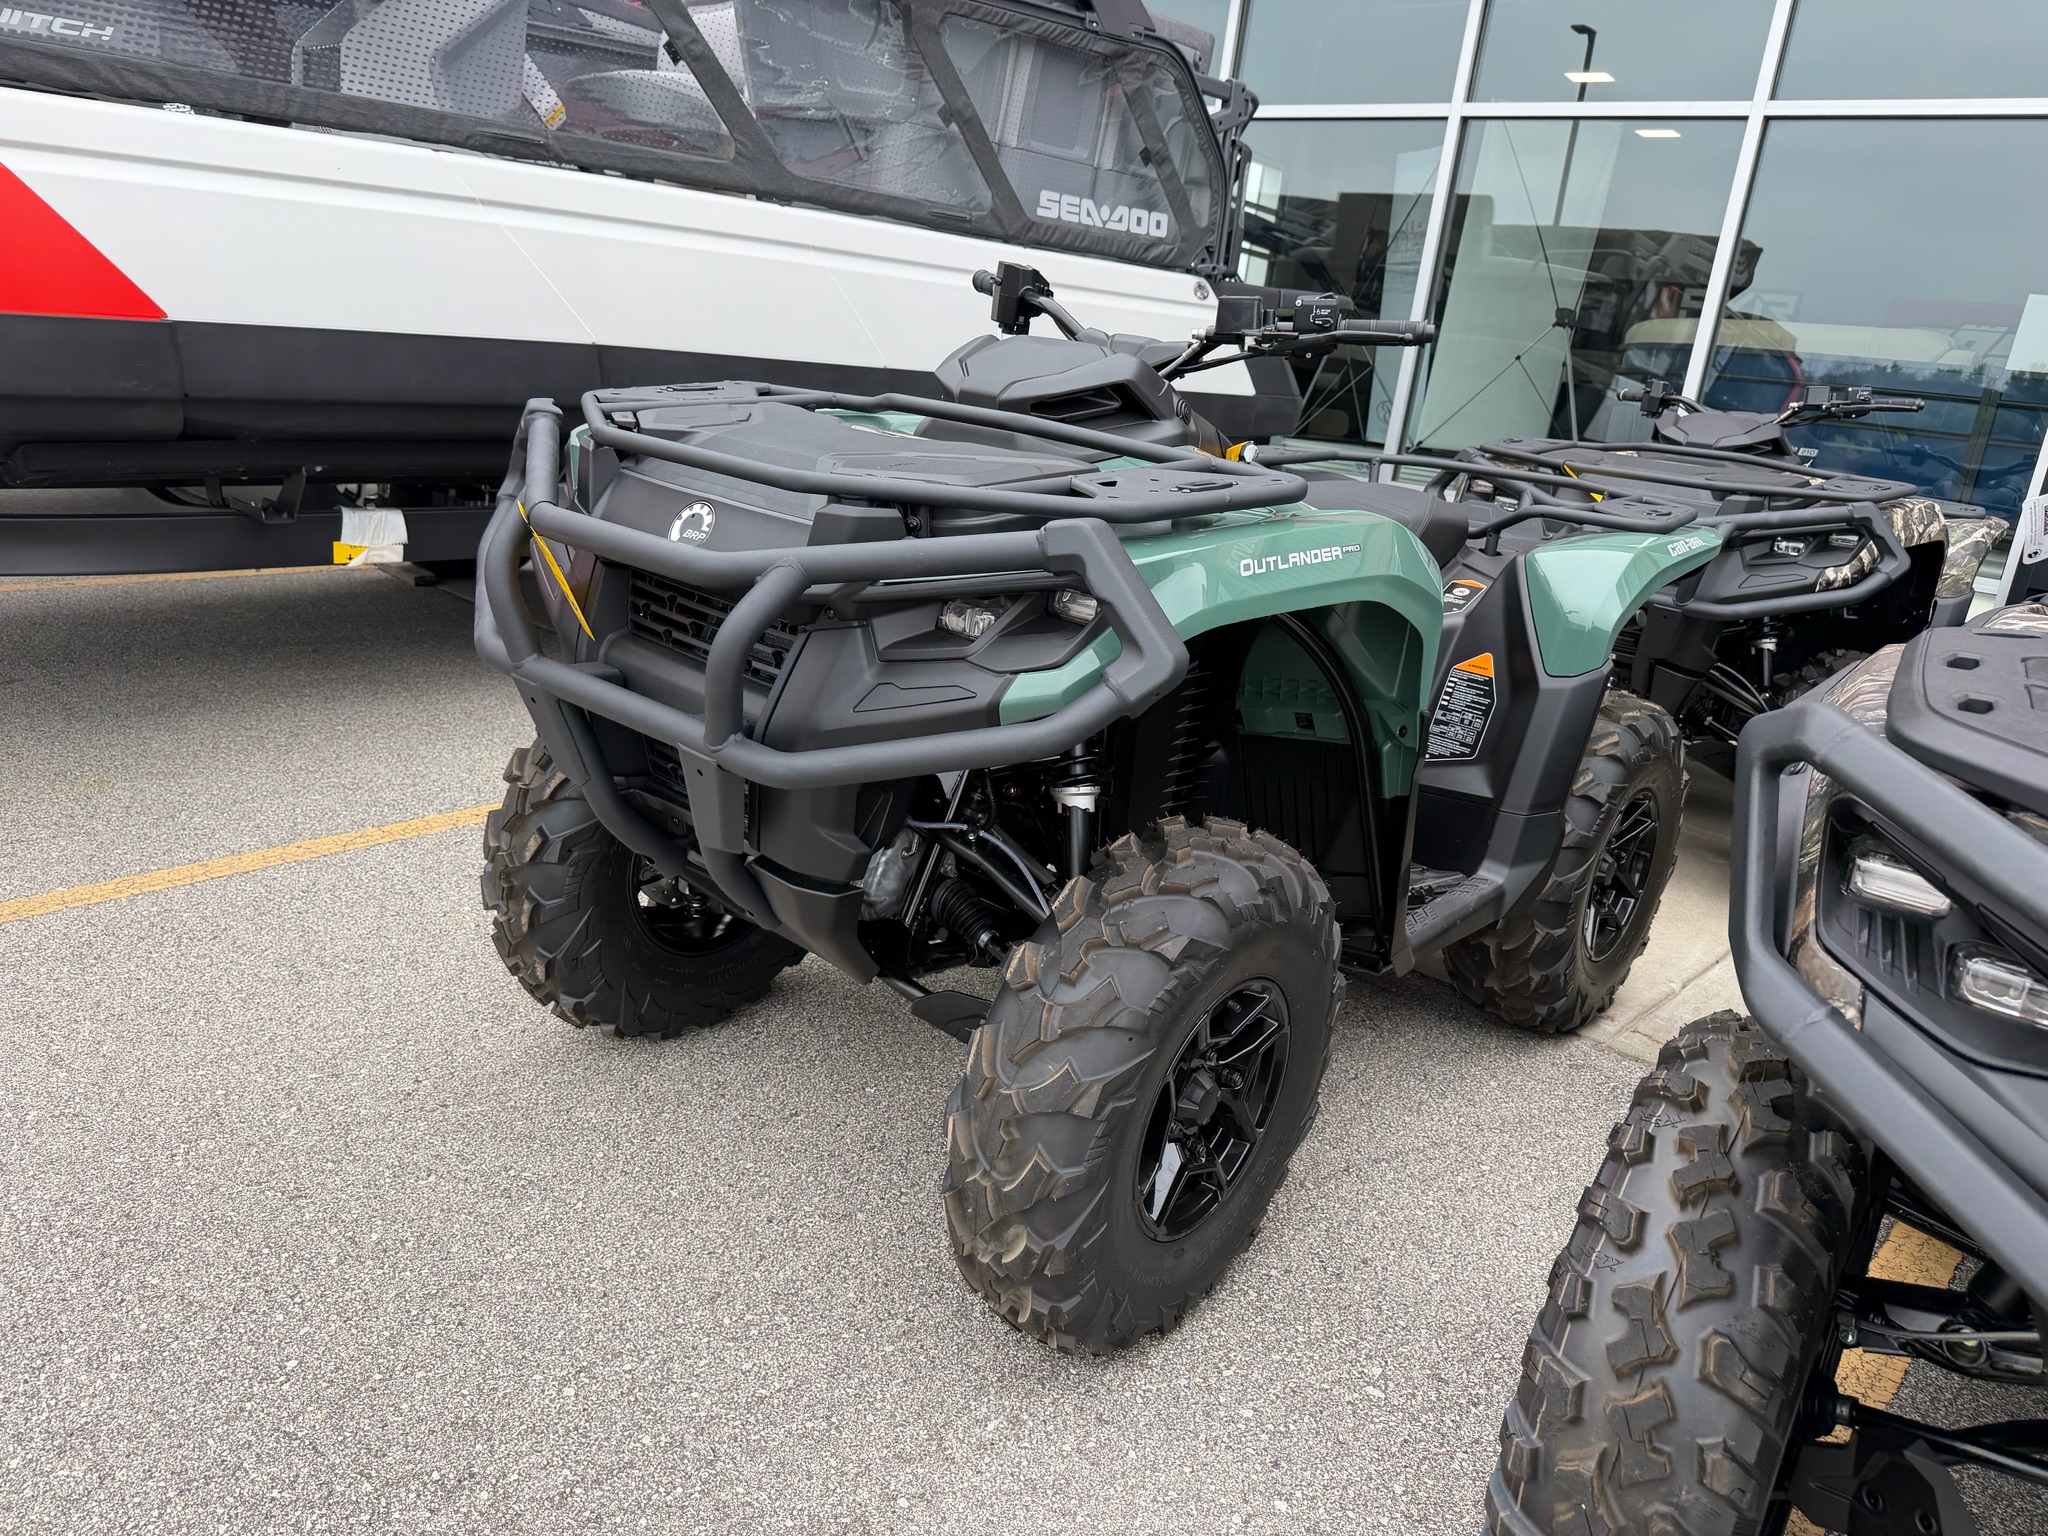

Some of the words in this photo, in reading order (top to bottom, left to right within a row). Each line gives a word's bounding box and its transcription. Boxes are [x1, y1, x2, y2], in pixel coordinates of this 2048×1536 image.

[682, 529, 707, 541] BRP
[1240, 546, 1342, 577] OUTLANDER
[1343, 544, 1360, 553] PRO
